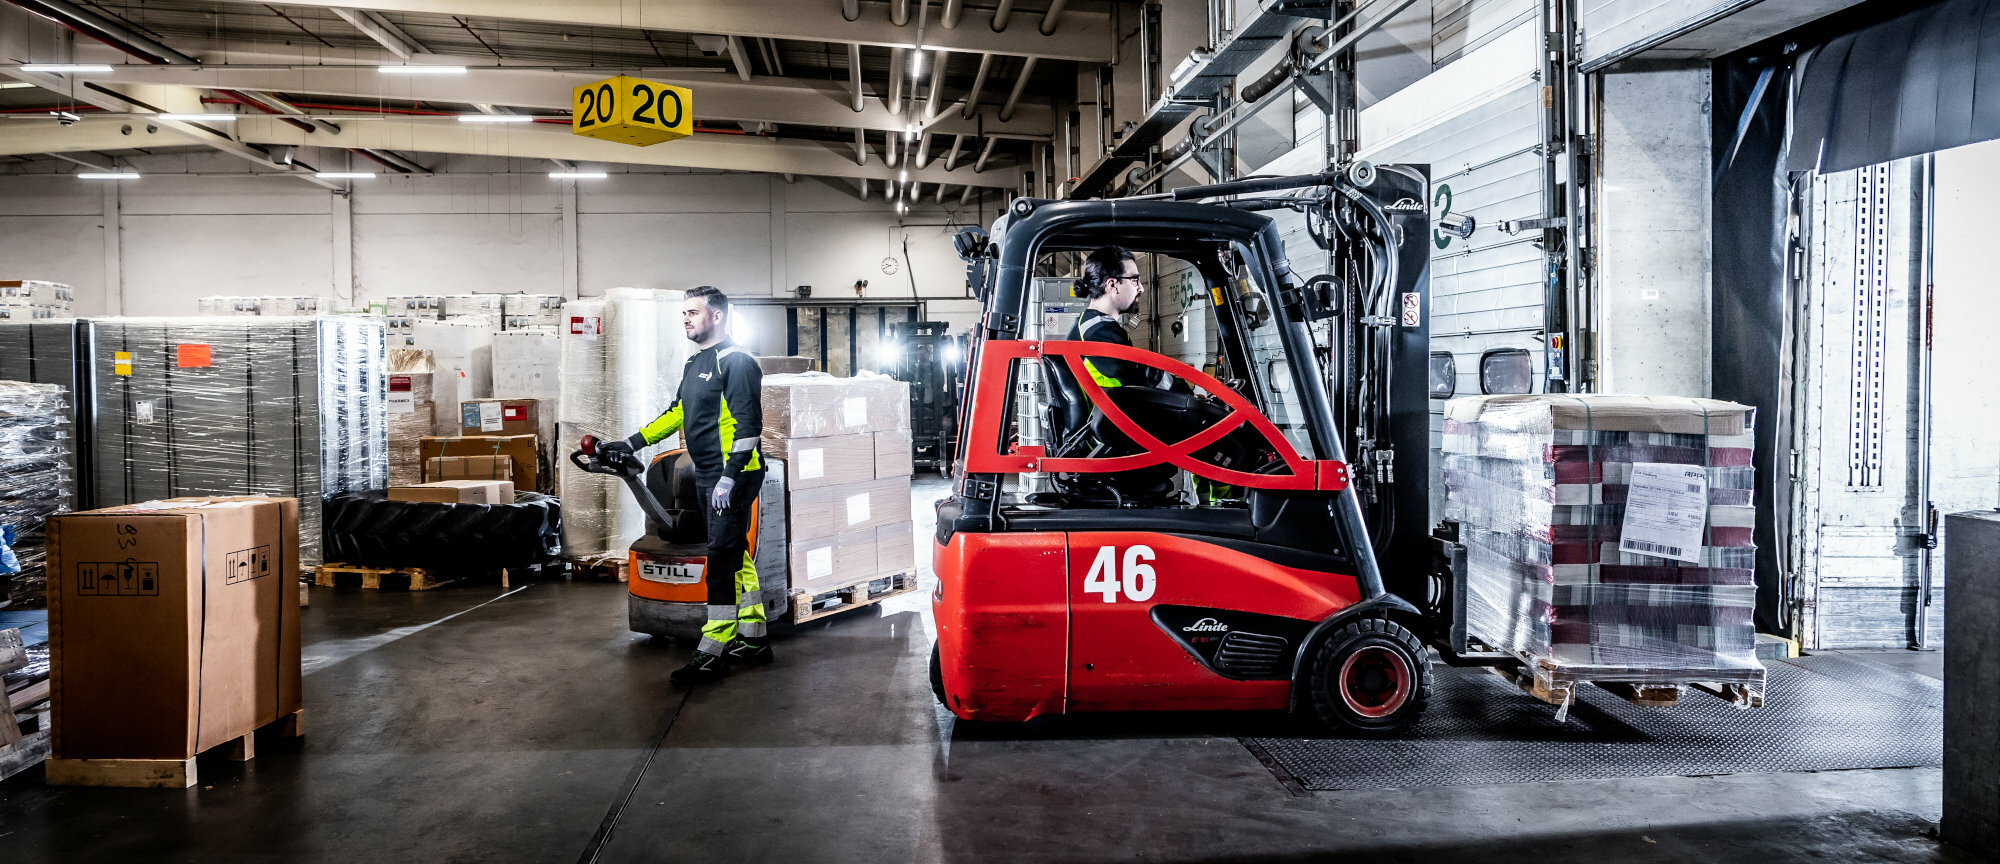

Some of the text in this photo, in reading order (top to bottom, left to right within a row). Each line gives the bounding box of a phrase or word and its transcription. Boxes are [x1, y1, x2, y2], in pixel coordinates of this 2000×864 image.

[579, 84, 615, 128] 20
[632, 84, 682, 128] 20
[1384, 197, 1424, 211] Linde
[1180, 271, 1194, 309] 55
[643, 564, 695, 578] STILL
[1083, 544, 1157, 604] 46
[1182, 617, 1228, 632] Linde
